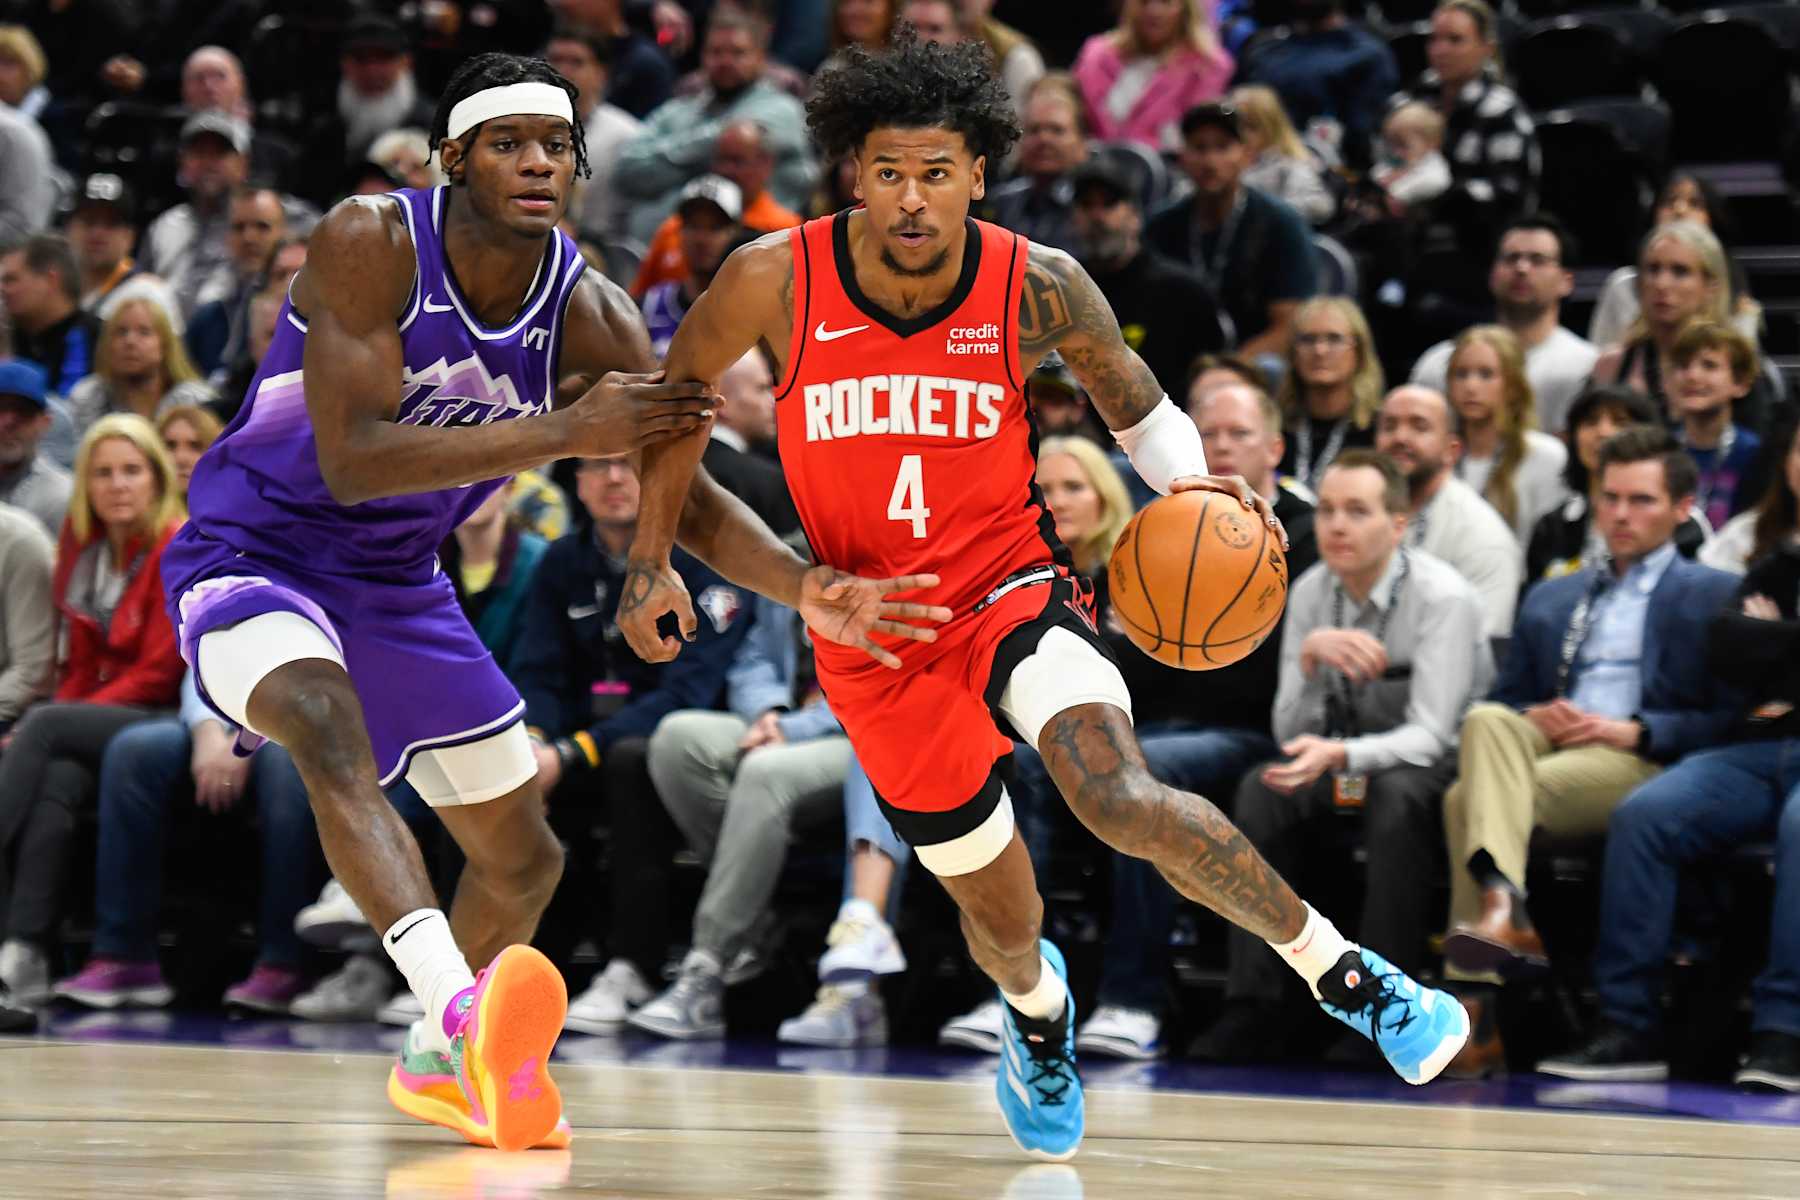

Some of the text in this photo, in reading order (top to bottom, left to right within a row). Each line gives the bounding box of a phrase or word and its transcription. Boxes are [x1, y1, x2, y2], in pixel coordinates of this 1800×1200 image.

[946, 339, 999, 354] karma
[949, 323, 999, 339] credit
[803, 374, 1005, 442] ROCKETS
[887, 454, 931, 539] 4
